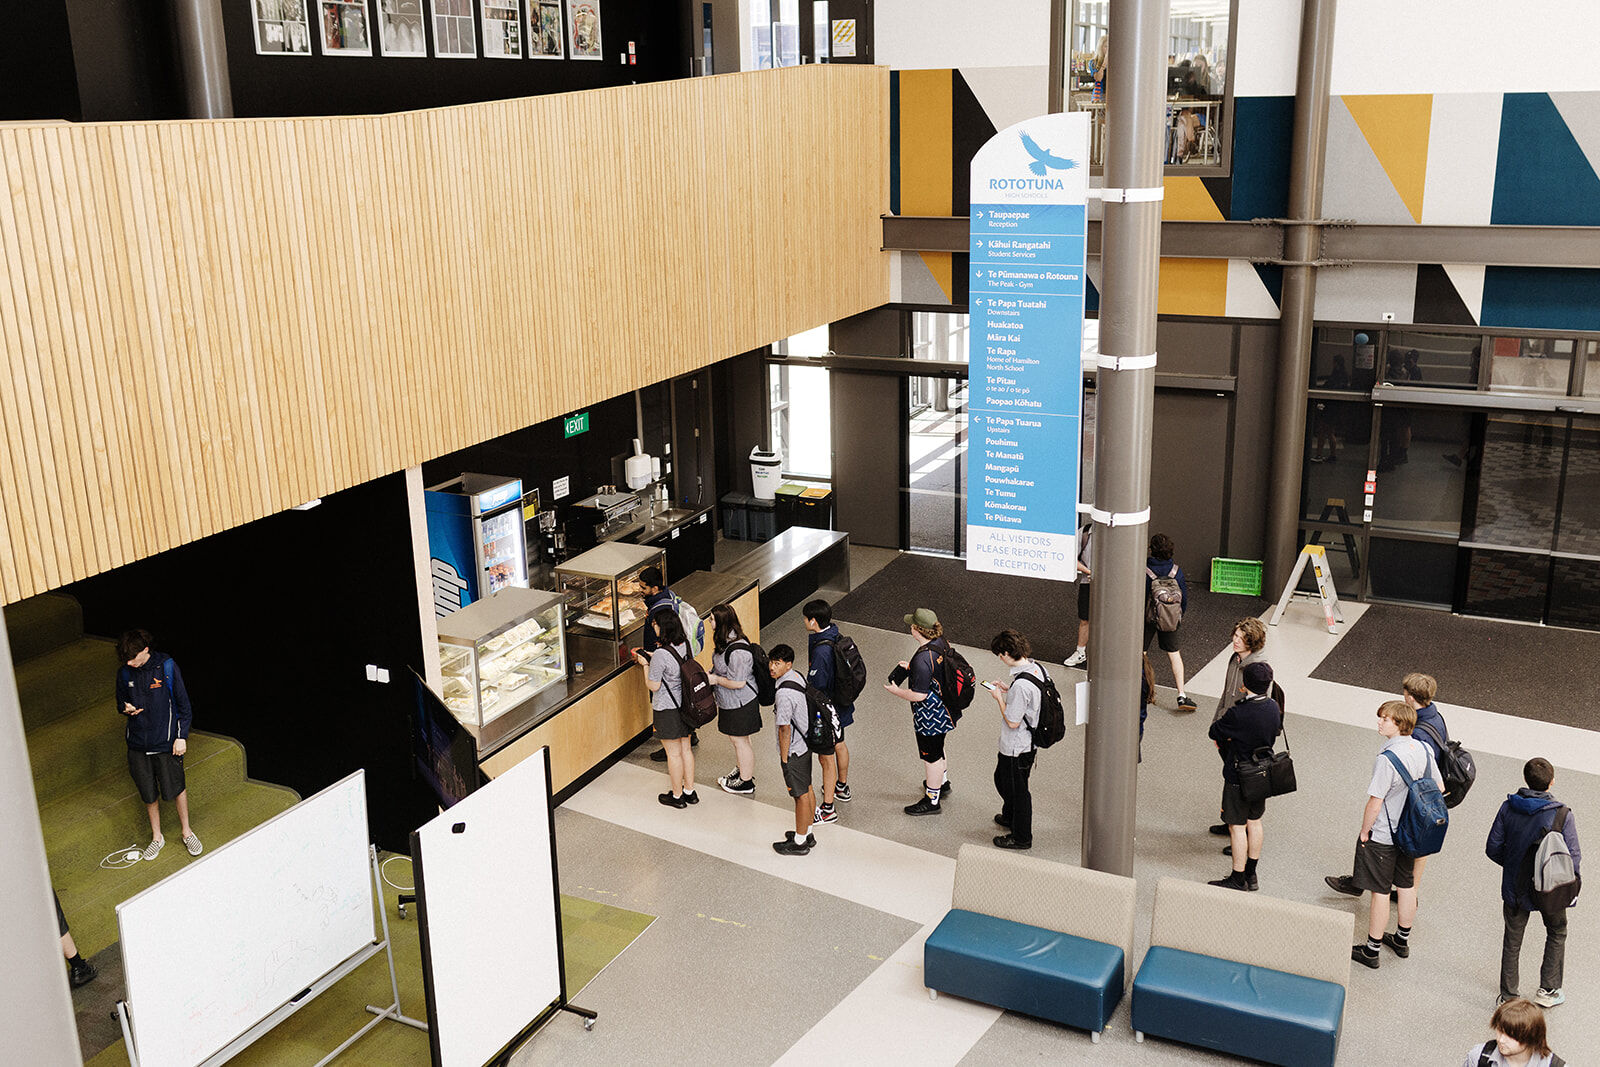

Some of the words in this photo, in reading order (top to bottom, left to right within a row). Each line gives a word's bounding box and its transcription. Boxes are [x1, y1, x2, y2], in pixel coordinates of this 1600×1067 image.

[990, 178, 1064, 190] ROTOTUNA
[988, 210, 1030, 220] Taupaepae
[1012, 240, 1051, 250] Rangatahi
[988, 270, 998, 278] Te
[1046, 272, 1079, 280] Rotouna
[998, 300, 1017, 309] Papa
[1017, 300, 1047, 309] Tuatahi
[987, 320, 1024, 329] Huakatoa
[1008, 334, 1020, 342] Kai
[997, 348, 1016, 356] Rapa
[986, 397, 1014, 406] Paopao
[570, 417, 584, 434] EXIT
[996, 417, 1014, 426] Papa
[1016, 418, 1041, 427] Tuarua
[986, 438, 1018, 446] Pouhimu
[985, 476, 1034, 486] Pouwhakarae
[995, 489, 1016, 498] Tumu
[990, 533, 1006, 542] ALL
[1008, 535, 1052, 546] VISITORS
[976, 544, 1009, 555] PLEASE
[1011, 548, 1048, 559] REPORT
[1051, 552, 1064, 561] TO
[994, 558, 1046, 572] RECEPTION
